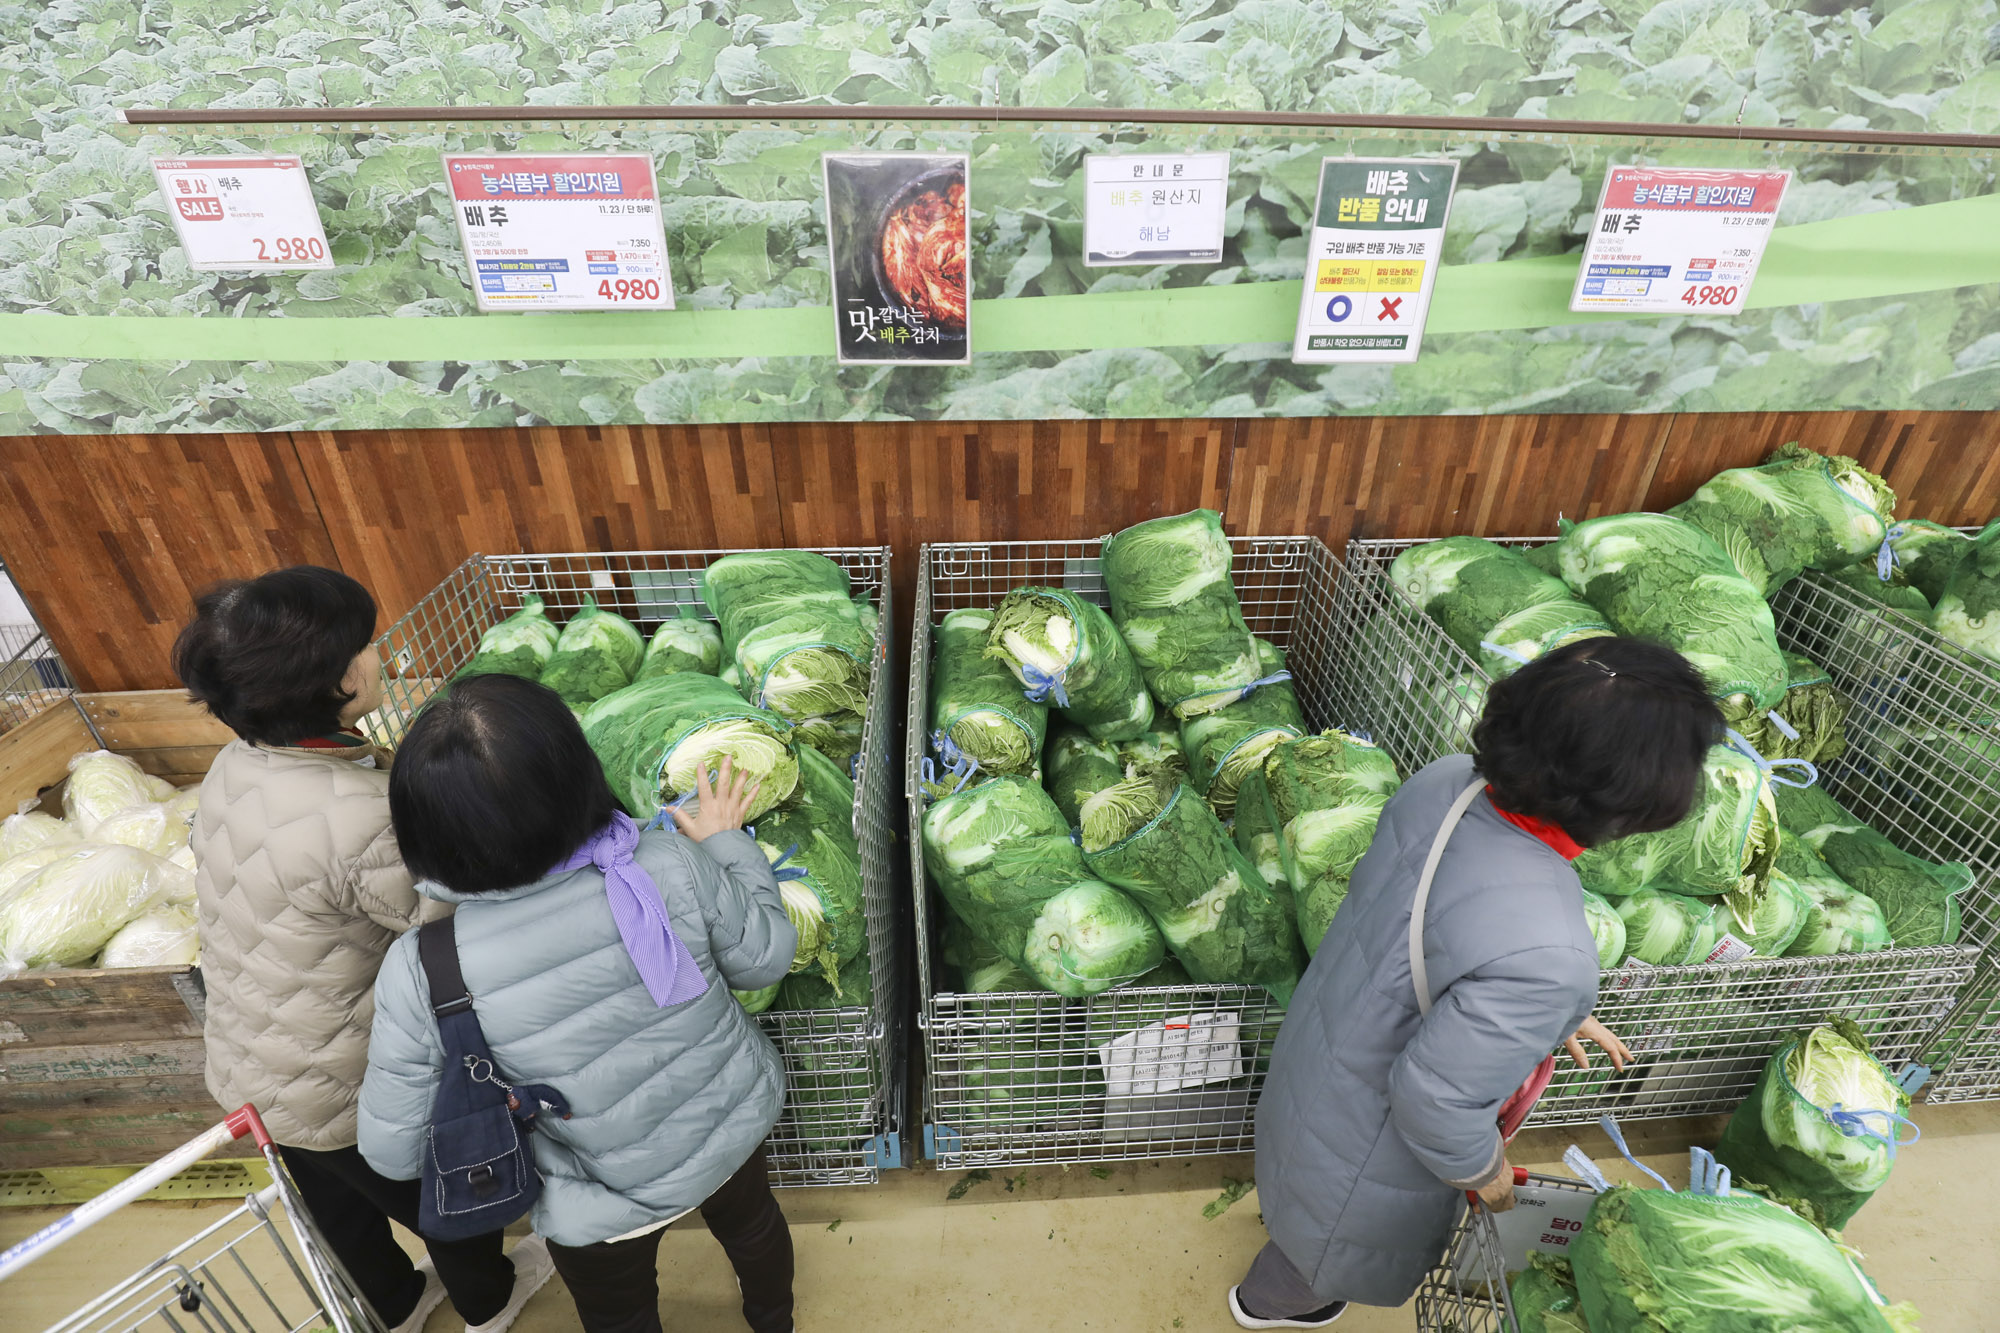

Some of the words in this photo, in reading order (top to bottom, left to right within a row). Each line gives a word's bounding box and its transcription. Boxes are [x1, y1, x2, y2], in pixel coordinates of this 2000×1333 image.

[1134, 164, 1184, 177] 안내문
[176, 178, 208, 194] 행사
[218, 177, 242, 191] 배추
[482, 172, 552, 194] 농식품부
[552, 172, 622, 194] 할인지원
[1366, 170, 1409, 195] 배추
[1110, 190, 1144, 207] 배추
[1152, 188, 1201, 206] 원산지
[1633, 184, 1694, 204] 농식품부
[1695, 185, 1755, 206] 할인지원
[180, 201, 221, 216] SALE
[464, 205, 508, 227] 배추
[609, 205, 620, 214] 23
[627, 205, 635, 214] 단
[636, 205, 654, 214] 하루!
[1338, 198, 1381, 222] 반품
[1384, 198, 1428, 222] 안내
[1601, 214, 1642, 234] 배추
[1731, 217, 1741, 225] 23
[1746, 218, 1754, 226] 단
[1754, 218, 1769, 226] 하루!
[1139, 226, 1171, 242] 해남
[252, 237, 324, 263] 2,980
[630, 239, 651, 247] 7,350
[1326, 242, 1344, 254] 구입
[1346, 242, 1364, 254] 배추
[1366, 242, 1385, 254] 반품
[1387, 242, 1405, 254] 가능
[1406, 242, 1426, 254] 기준
[1733, 249, 1750, 257] 7,350
[598, 279, 660, 301] 4,980
[1681, 285, 1737, 306] 4,980
[880, 326, 940, 344] 배추김치
[1520, 1198, 1546, 1207] 강화군
[1540, 1233, 1569, 1246] 강화
